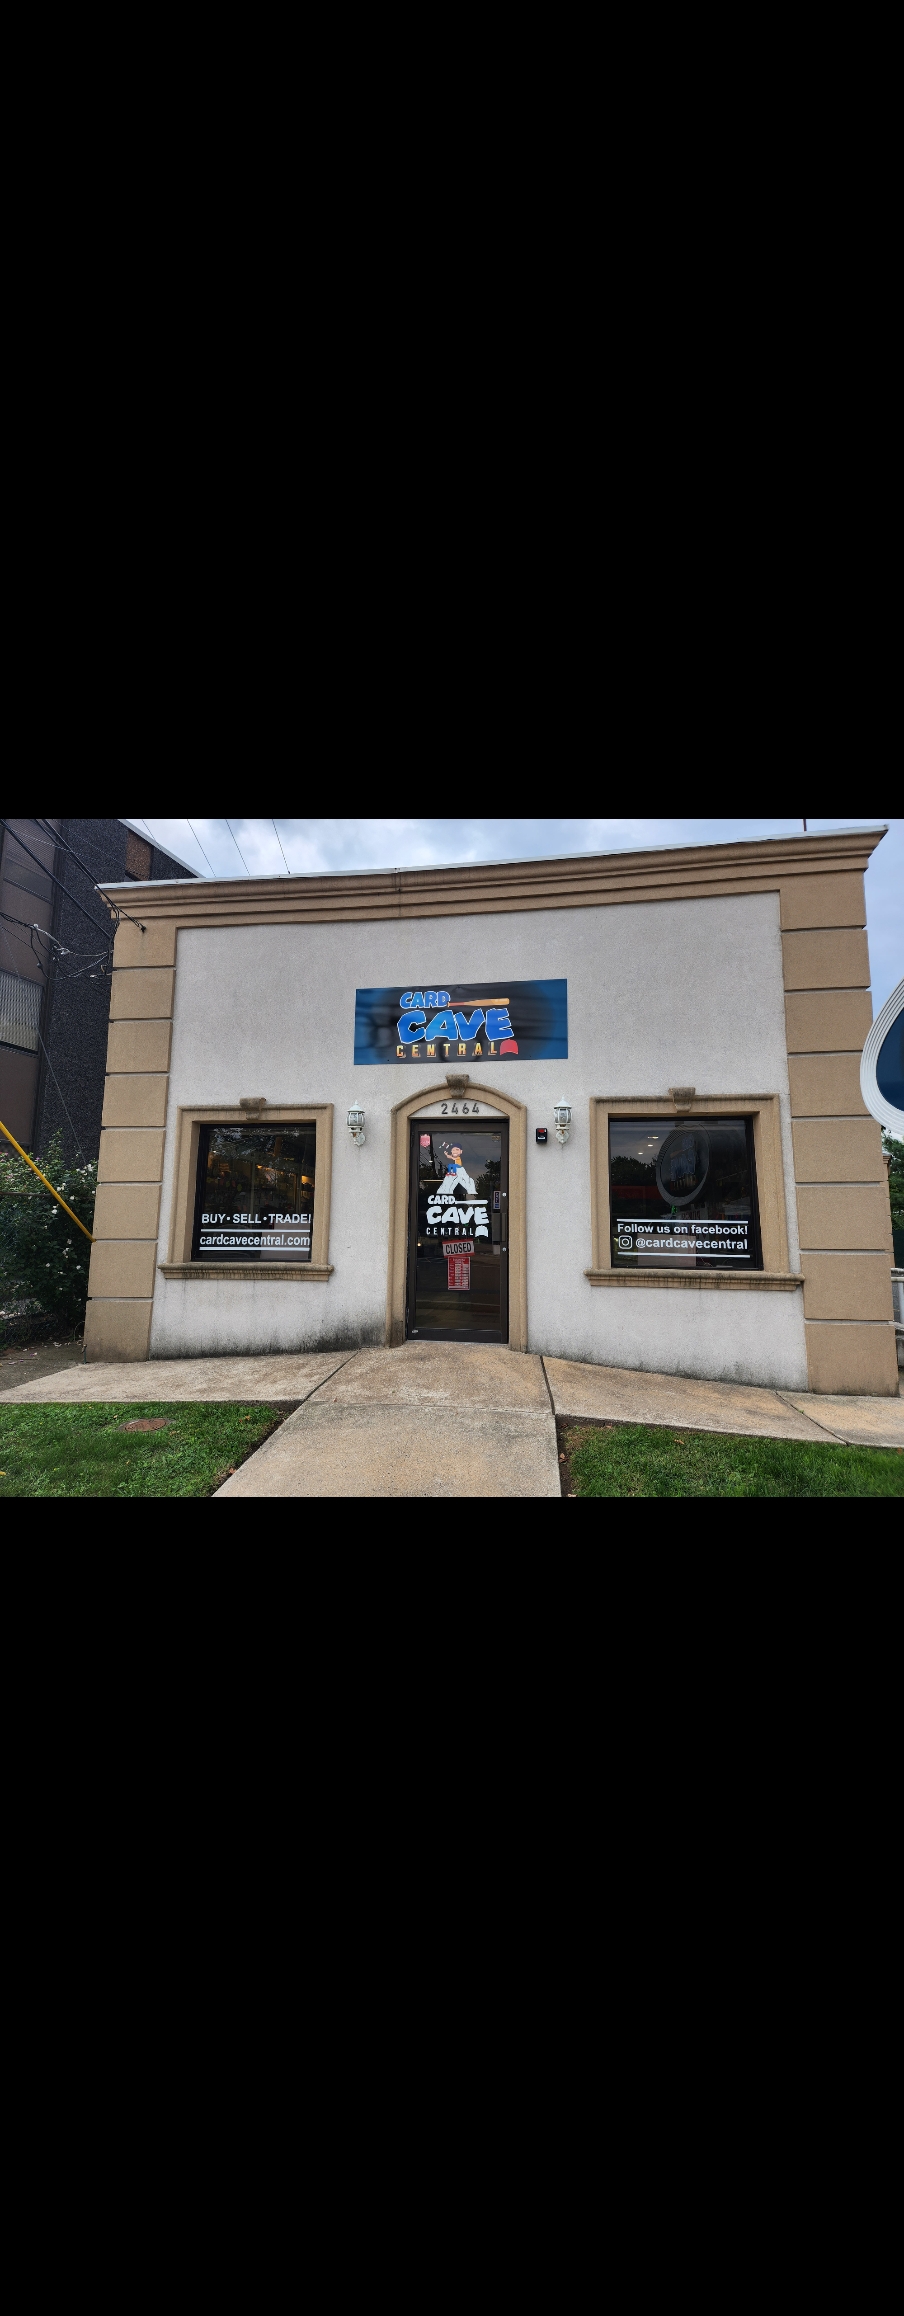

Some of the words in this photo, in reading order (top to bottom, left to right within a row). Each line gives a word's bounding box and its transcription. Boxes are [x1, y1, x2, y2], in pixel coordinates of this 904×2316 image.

[400, 990, 450, 1009] CARD
[397, 1008, 514, 1044] CAVE
[396, 1042, 498, 1058] CENTRAL
[441, 1103, 479, 1114] 2464
[427, 1195, 456, 1205] CARD
[201, 1213, 226, 1224] BUY
[232, 1213, 262, 1224] SELL
[268, 1213, 312, 1224] TRADE!
[426, 1206, 490, 1225] CAVE
[426, 1227, 474, 1236] CENTRAL
[617, 1223, 654, 1233] Follow
[657, 1225, 670, 1233] us
[673, 1225, 688, 1234] on
[691, 1225, 748, 1235] facebook!
[199, 1234, 311, 1246] cardcavecentral.com
[635, 1237, 748, 1250] @cardcavecentral
[446, 1242, 472, 1255] CLOSED
